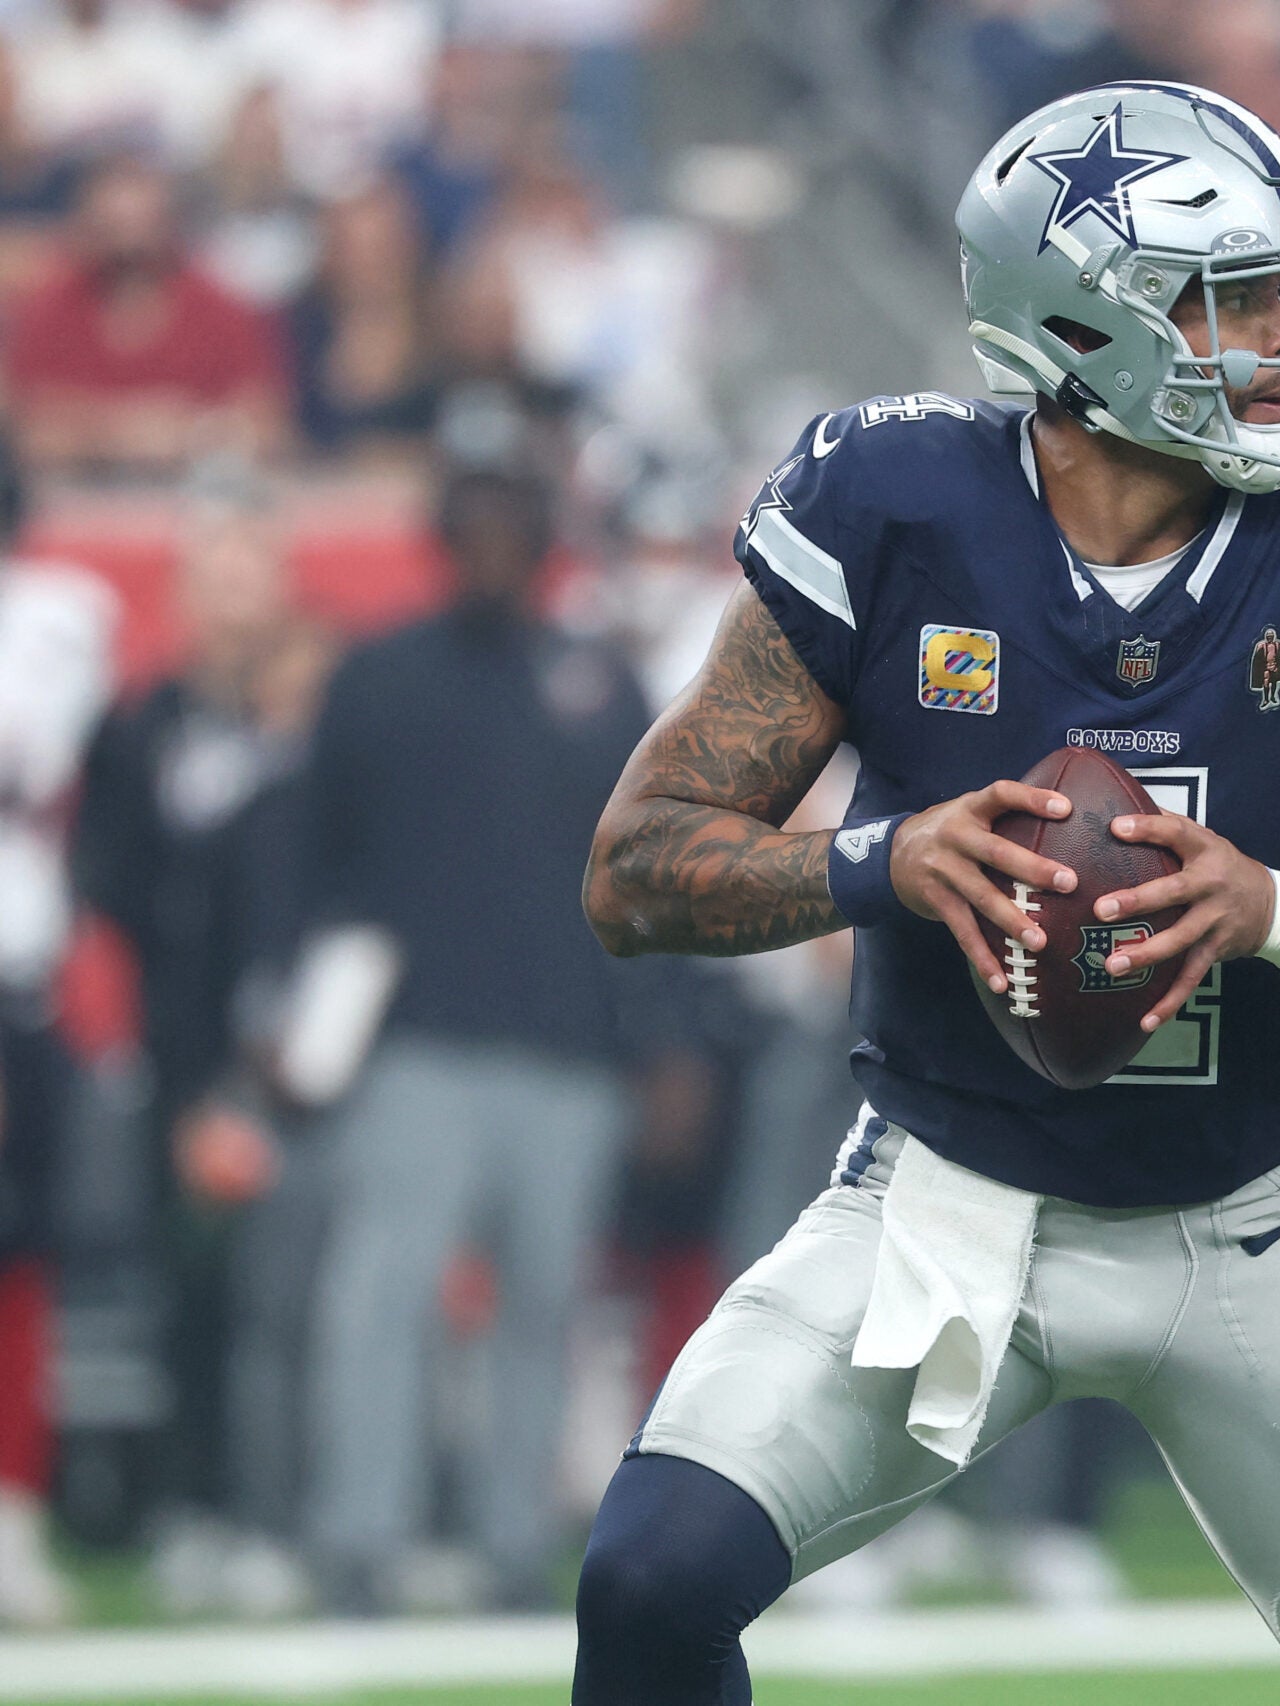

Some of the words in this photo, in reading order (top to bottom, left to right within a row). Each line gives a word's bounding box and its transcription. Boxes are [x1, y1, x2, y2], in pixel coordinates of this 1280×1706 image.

[859, 391, 975, 429] 4
[925, 632, 995, 692] C
[1122, 660, 1151, 679] NFL
[1066, 728, 1180, 754] COWBOYS
[834, 819, 892, 863] 4
